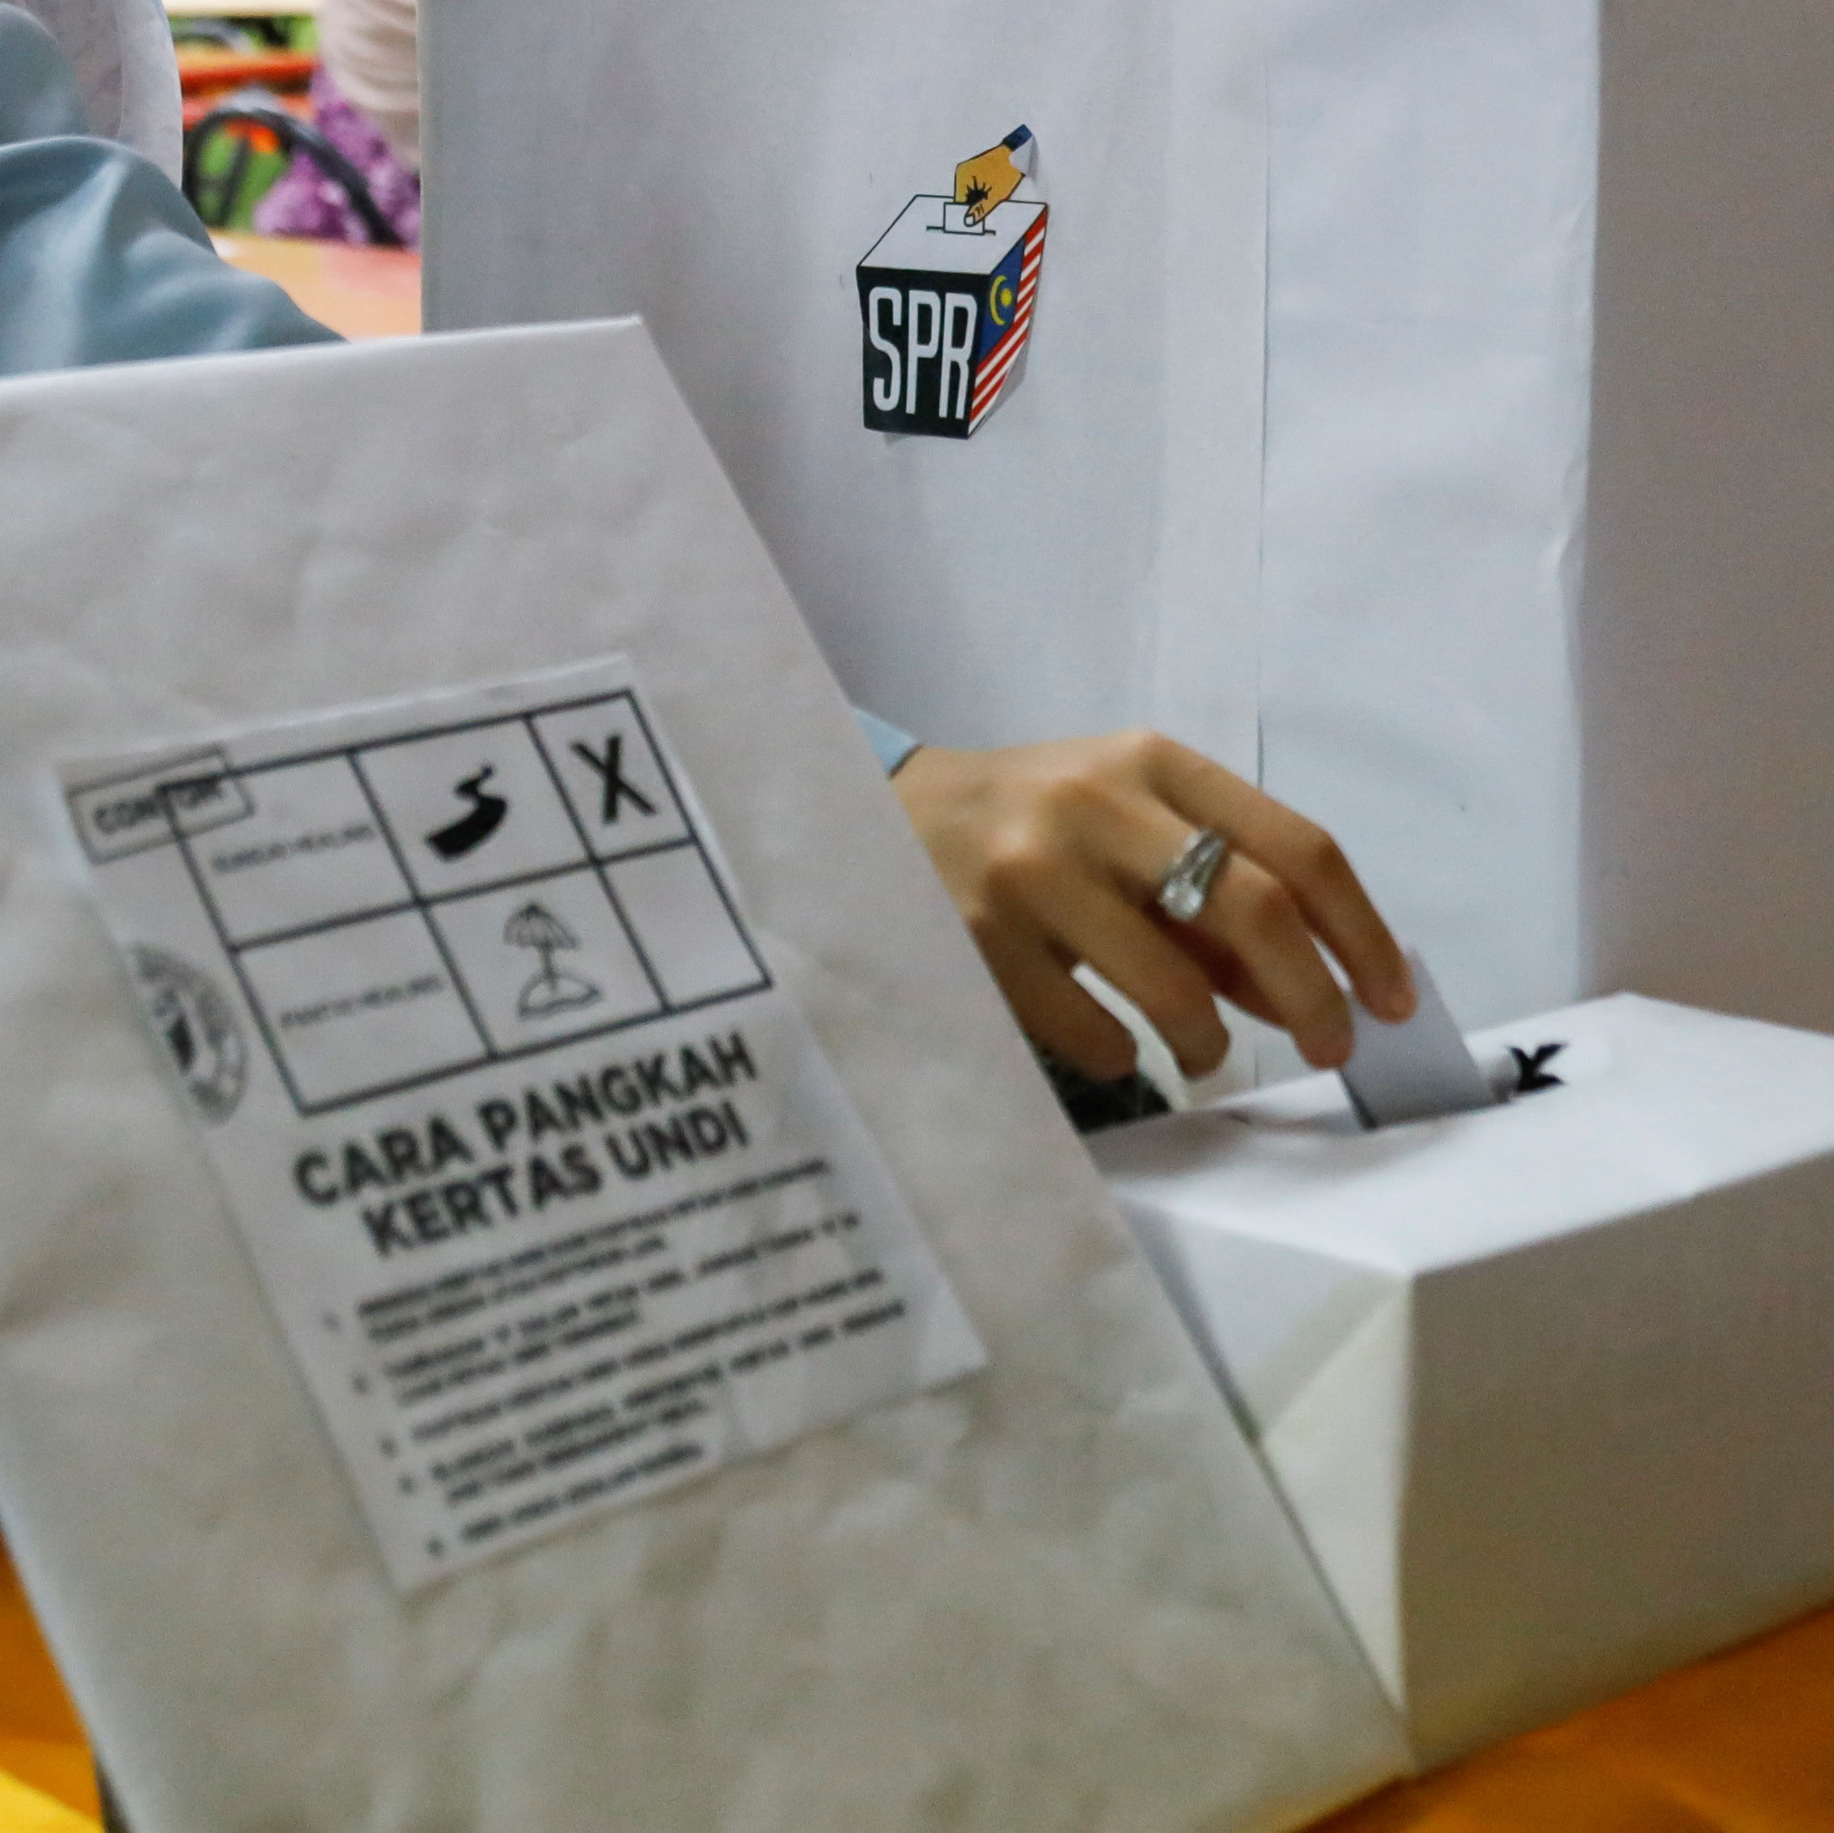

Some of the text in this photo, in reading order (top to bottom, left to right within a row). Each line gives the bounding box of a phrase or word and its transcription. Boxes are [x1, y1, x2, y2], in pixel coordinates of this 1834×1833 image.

[868, 285, 979, 420] SPR
[292, 1029, 760, 1209] CARA PANGKAH
[362, 1145, 605, 1261] KERTAS
[603, 1100, 750, 1181] UNDI
